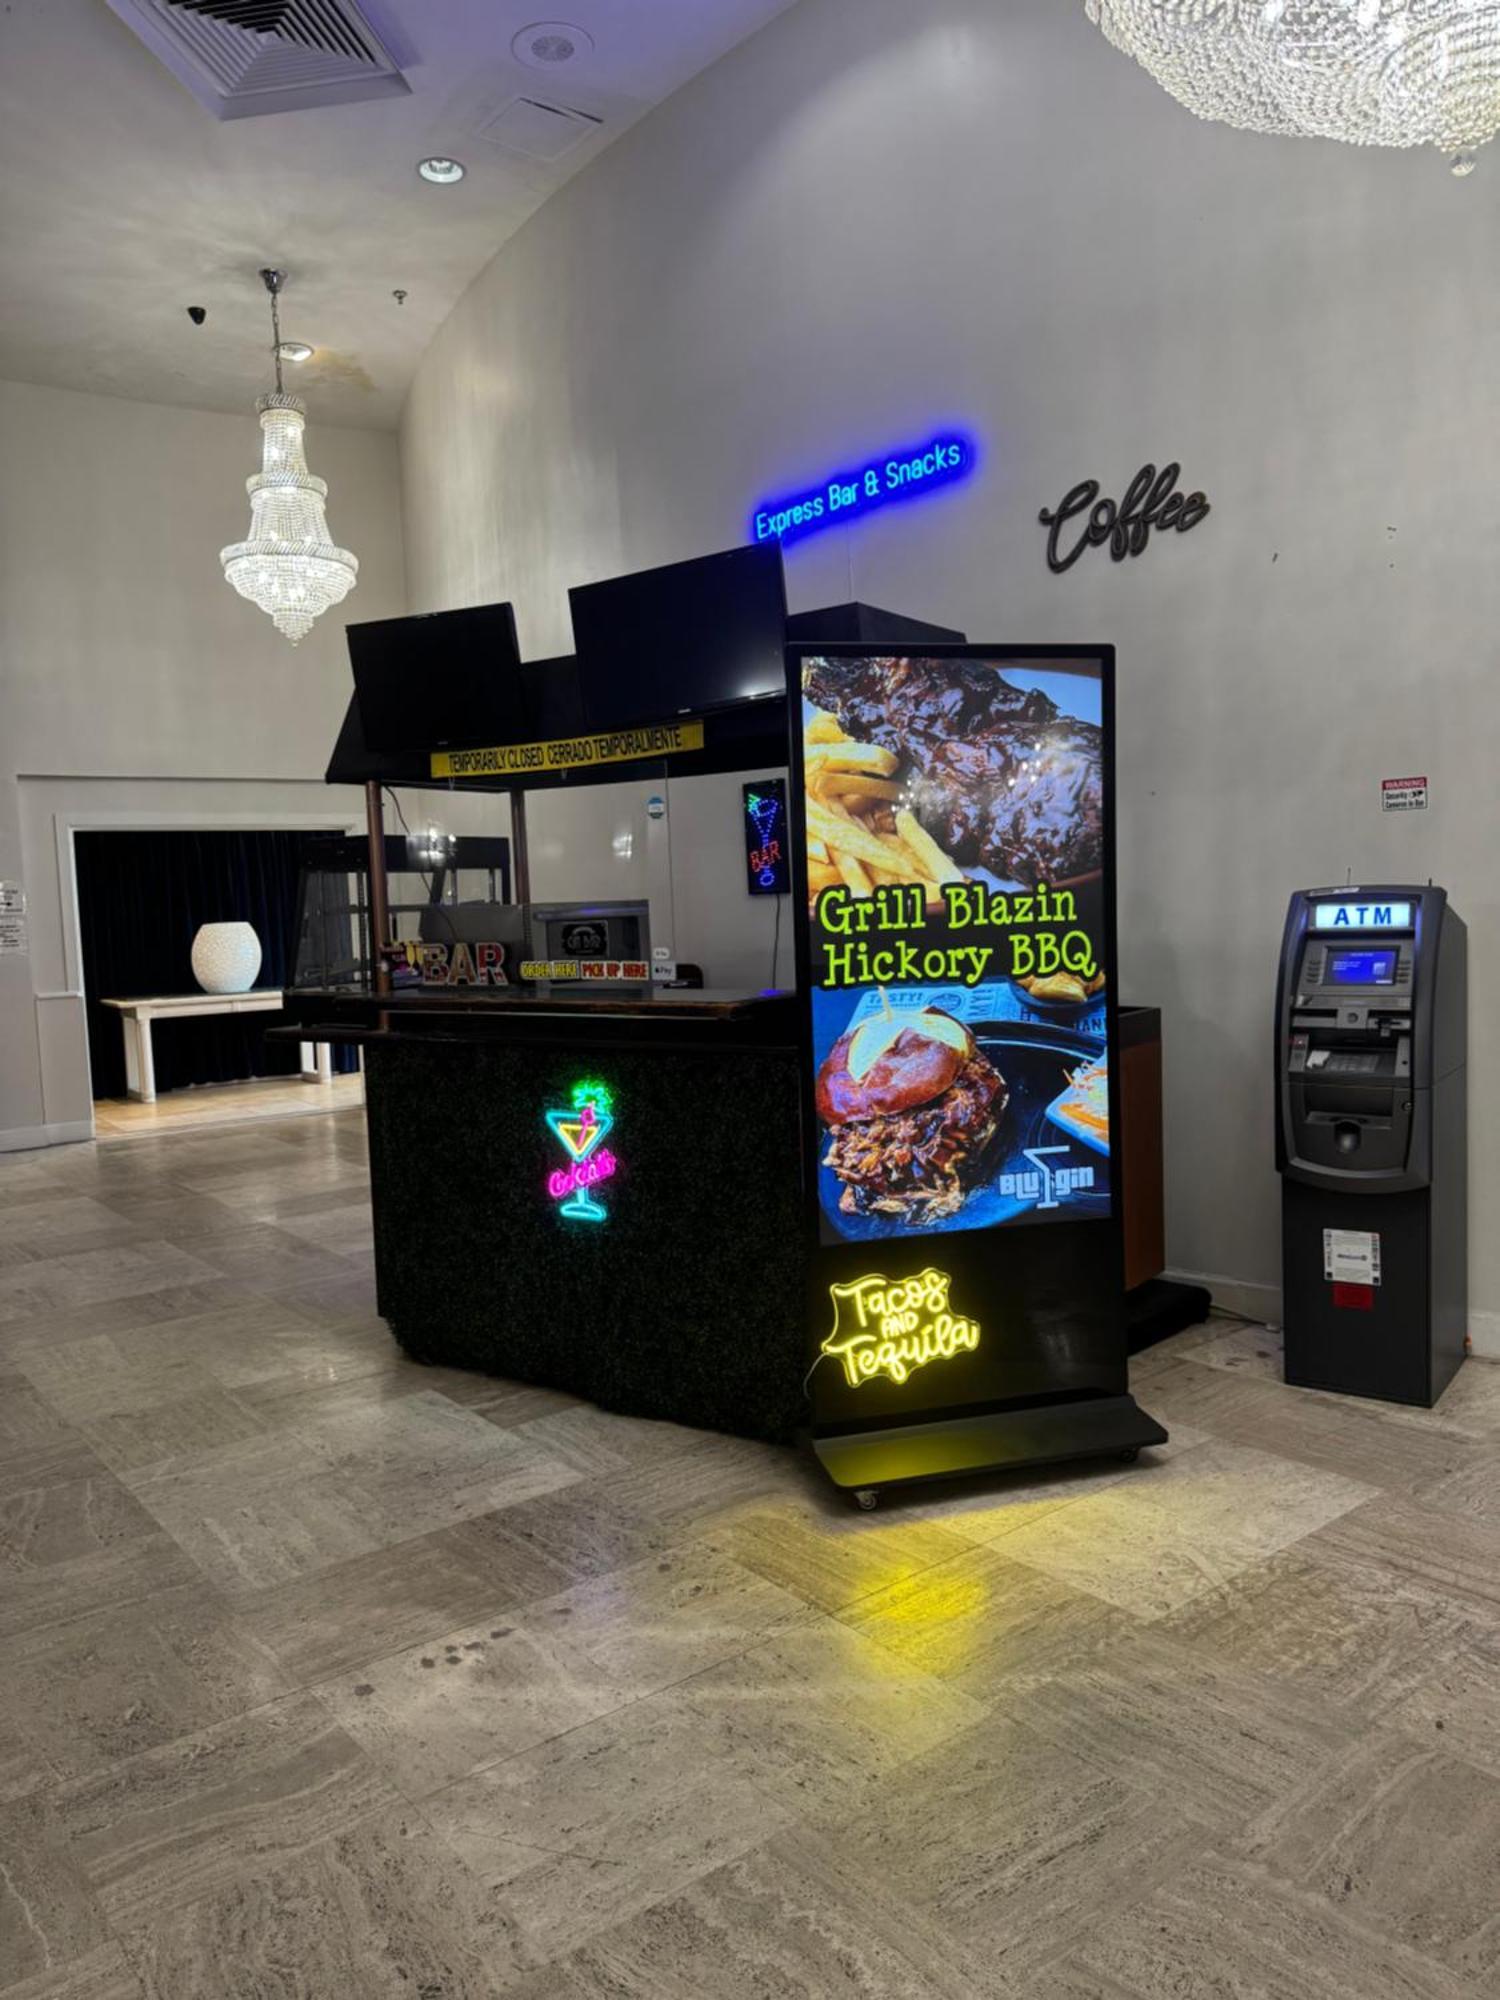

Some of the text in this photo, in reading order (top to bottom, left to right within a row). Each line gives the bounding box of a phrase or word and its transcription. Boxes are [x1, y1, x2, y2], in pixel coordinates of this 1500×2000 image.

[756, 444, 961, 539] Express Bar & Snacks
[1038, 462, 1210, 574] Coffee
[448, 727, 681, 773] TEMPORARILY CLOSED CERRADO TEMPORALMENTE
[751, 841, 781, 872] BAR
[819, 883, 1078, 935] Grill Blazin
[1334, 906, 1392, 926] ATM
[421, 942, 508, 986] BAR
[581, 962, 646, 978] PICK UP HERE
[822, 930, 1097, 986] Hickory BBQ
[1000, 1171, 1039, 1199] BLU
[833, 1272, 949, 1328] Tacos
[881, 1311, 919, 1338] AND
[825, 1314, 980, 1385] Tequila
